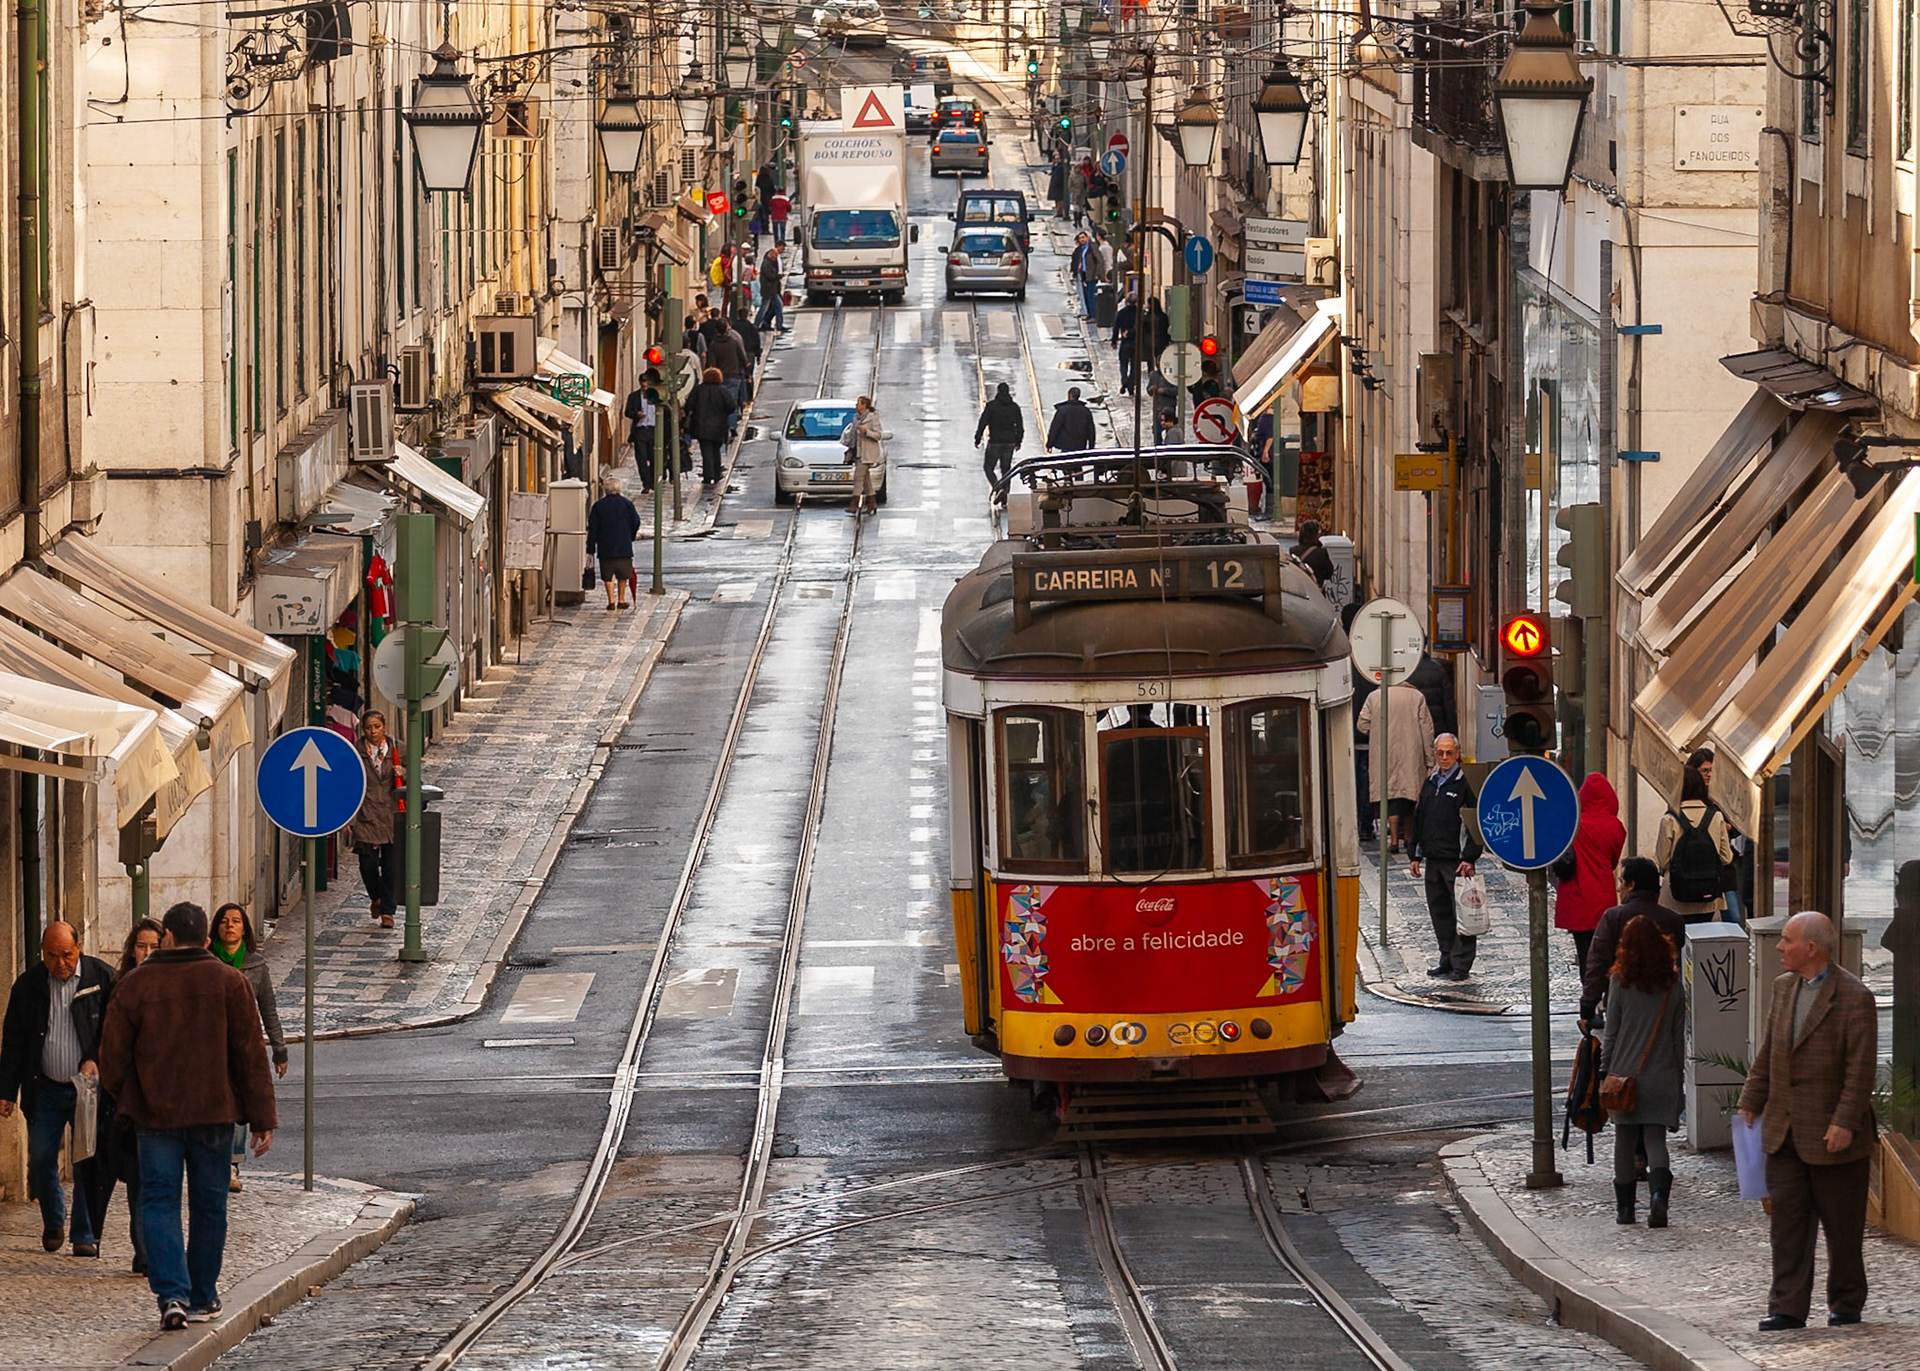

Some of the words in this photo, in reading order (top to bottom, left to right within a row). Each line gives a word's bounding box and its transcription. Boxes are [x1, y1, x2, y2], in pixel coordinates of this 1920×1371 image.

[1710, 114, 1729, 125] RUA
[824, 138, 882, 149] COLCHÕES
[1710, 133, 1730, 143] DOS
[814, 151, 838, 159] BOM
[841, 150, 893, 159] REPOUSO
[1689, 151, 1751, 161] FANQUEIROS
[1246, 223, 1289, 236] Restauradores
[1246, 254, 1265, 265] Rossio
[1034, 568, 1139, 592] CARREIRA
[1206, 560, 1245, 589] 12
[1137, 682, 1164, 697] 561
[1070, 933, 1117, 951] abre
[1122, 937, 1135, 951] a
[1141, 928, 1244, 951] felicidade
